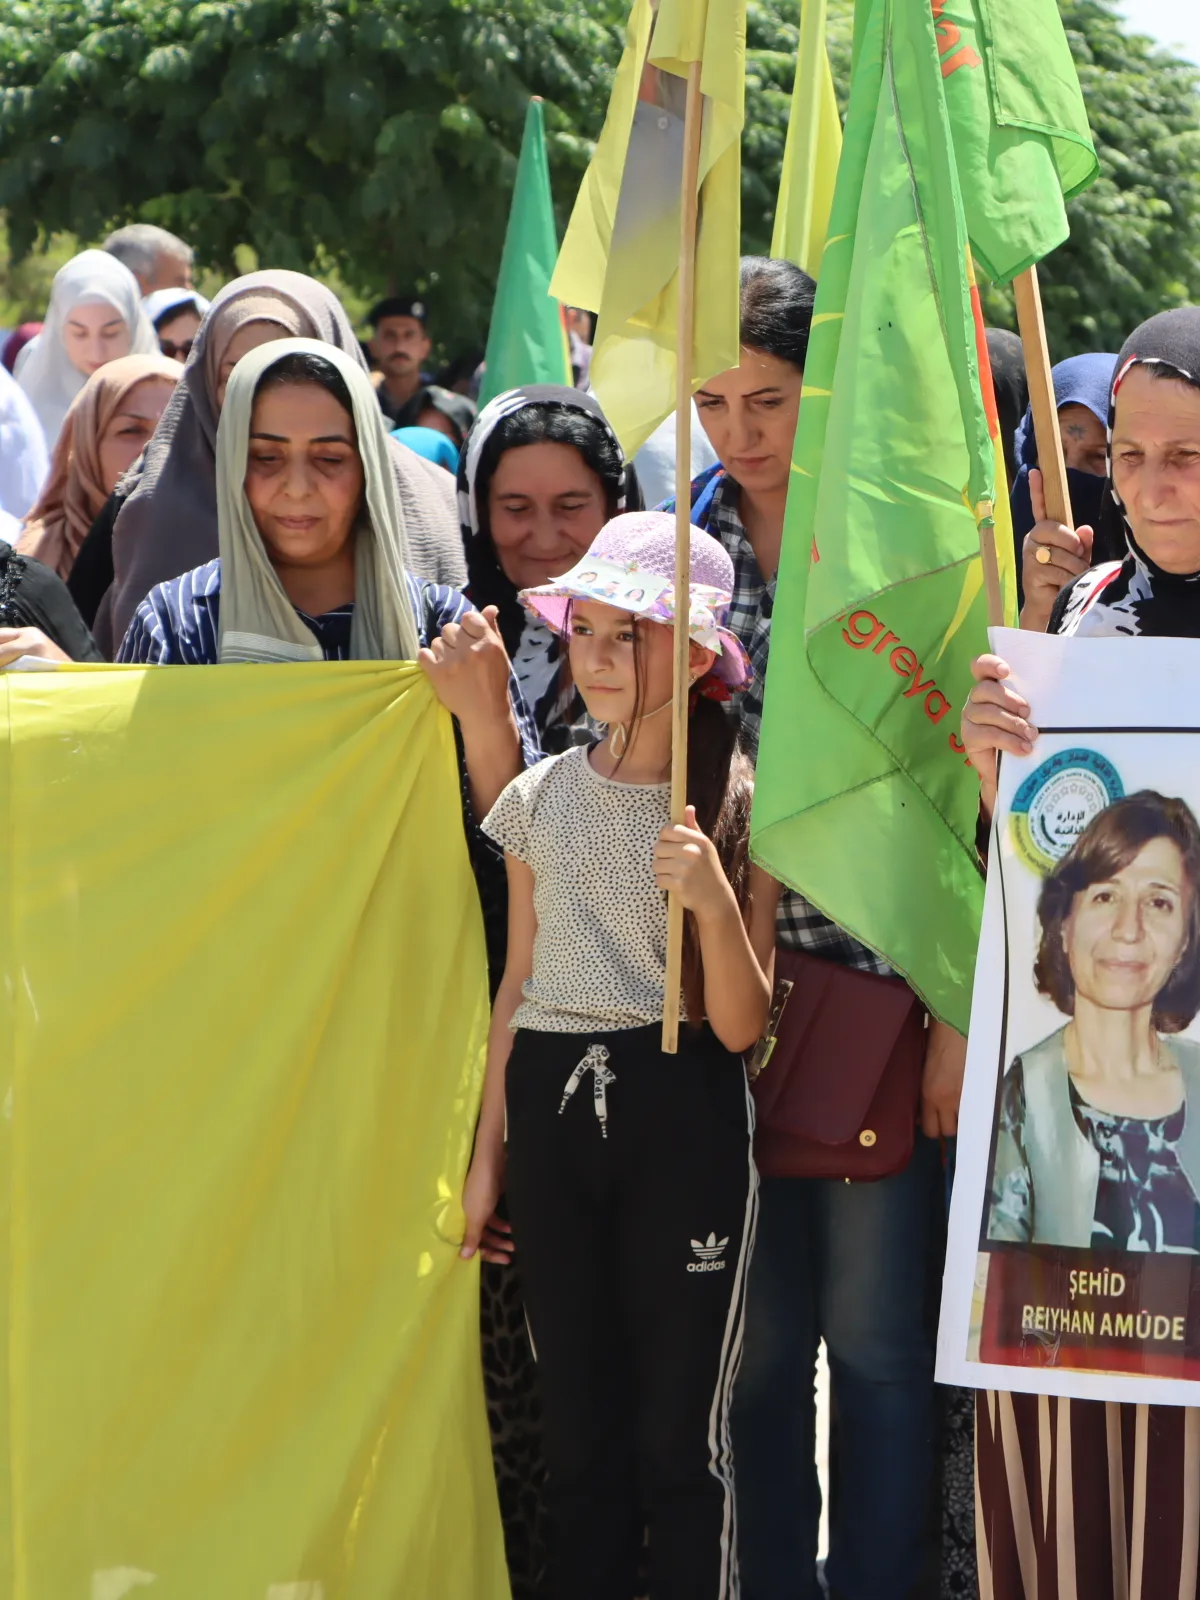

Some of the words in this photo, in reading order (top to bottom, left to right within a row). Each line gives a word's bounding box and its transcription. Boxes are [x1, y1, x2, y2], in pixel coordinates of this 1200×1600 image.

[837, 609, 952, 725] greya
[686, 1260, 726, 1273] adidas
[1069, 1267, 1126, 1300] ŞEHÎD
[1021, 1304, 1095, 1335] REIYHAN
